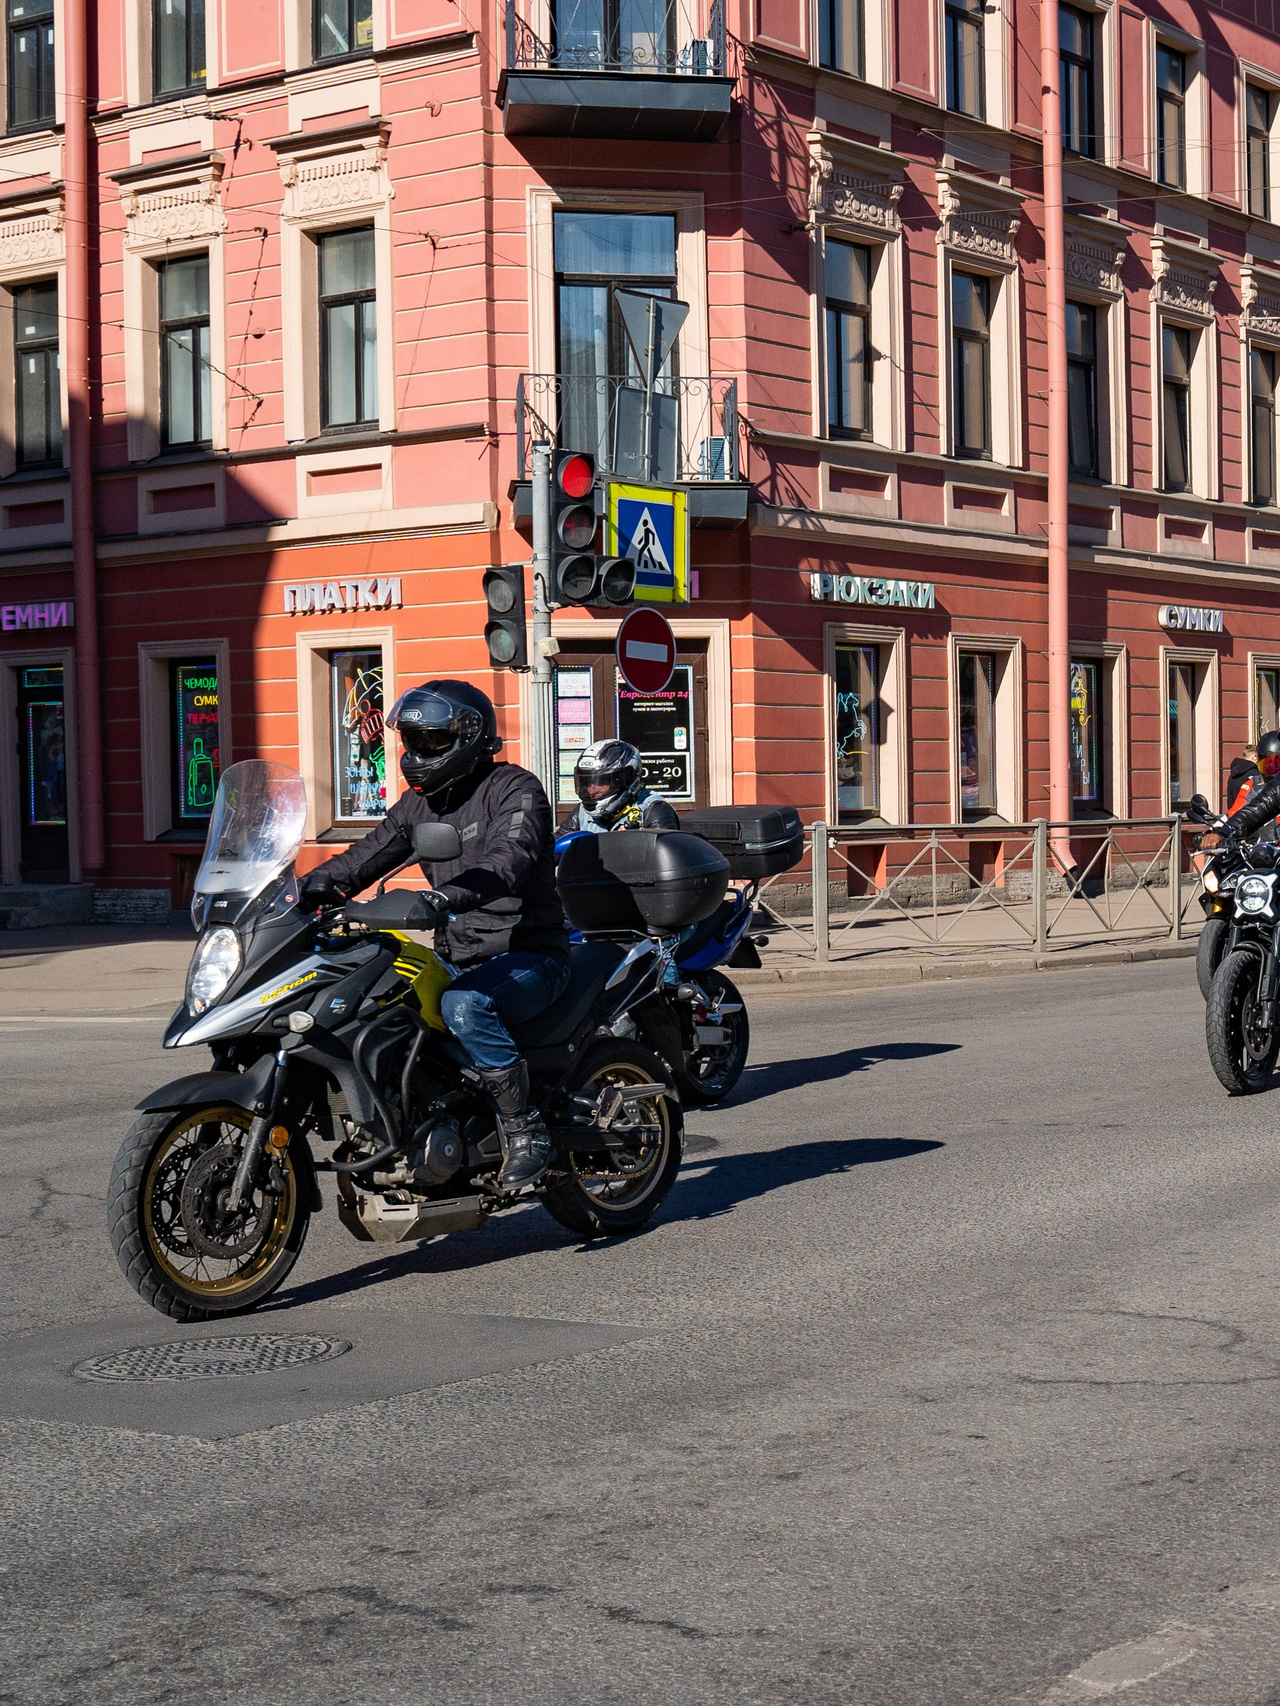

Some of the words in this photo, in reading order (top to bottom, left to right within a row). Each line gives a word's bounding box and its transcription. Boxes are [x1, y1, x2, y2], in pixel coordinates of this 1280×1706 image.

[284, 577, 402, 612] ПЛАТКИ
[811, 573, 935, 609] РЮКЗАКИ
[1158, 605, 1223, 632] СУМКИ
[663, 767, 682, 778] 20
